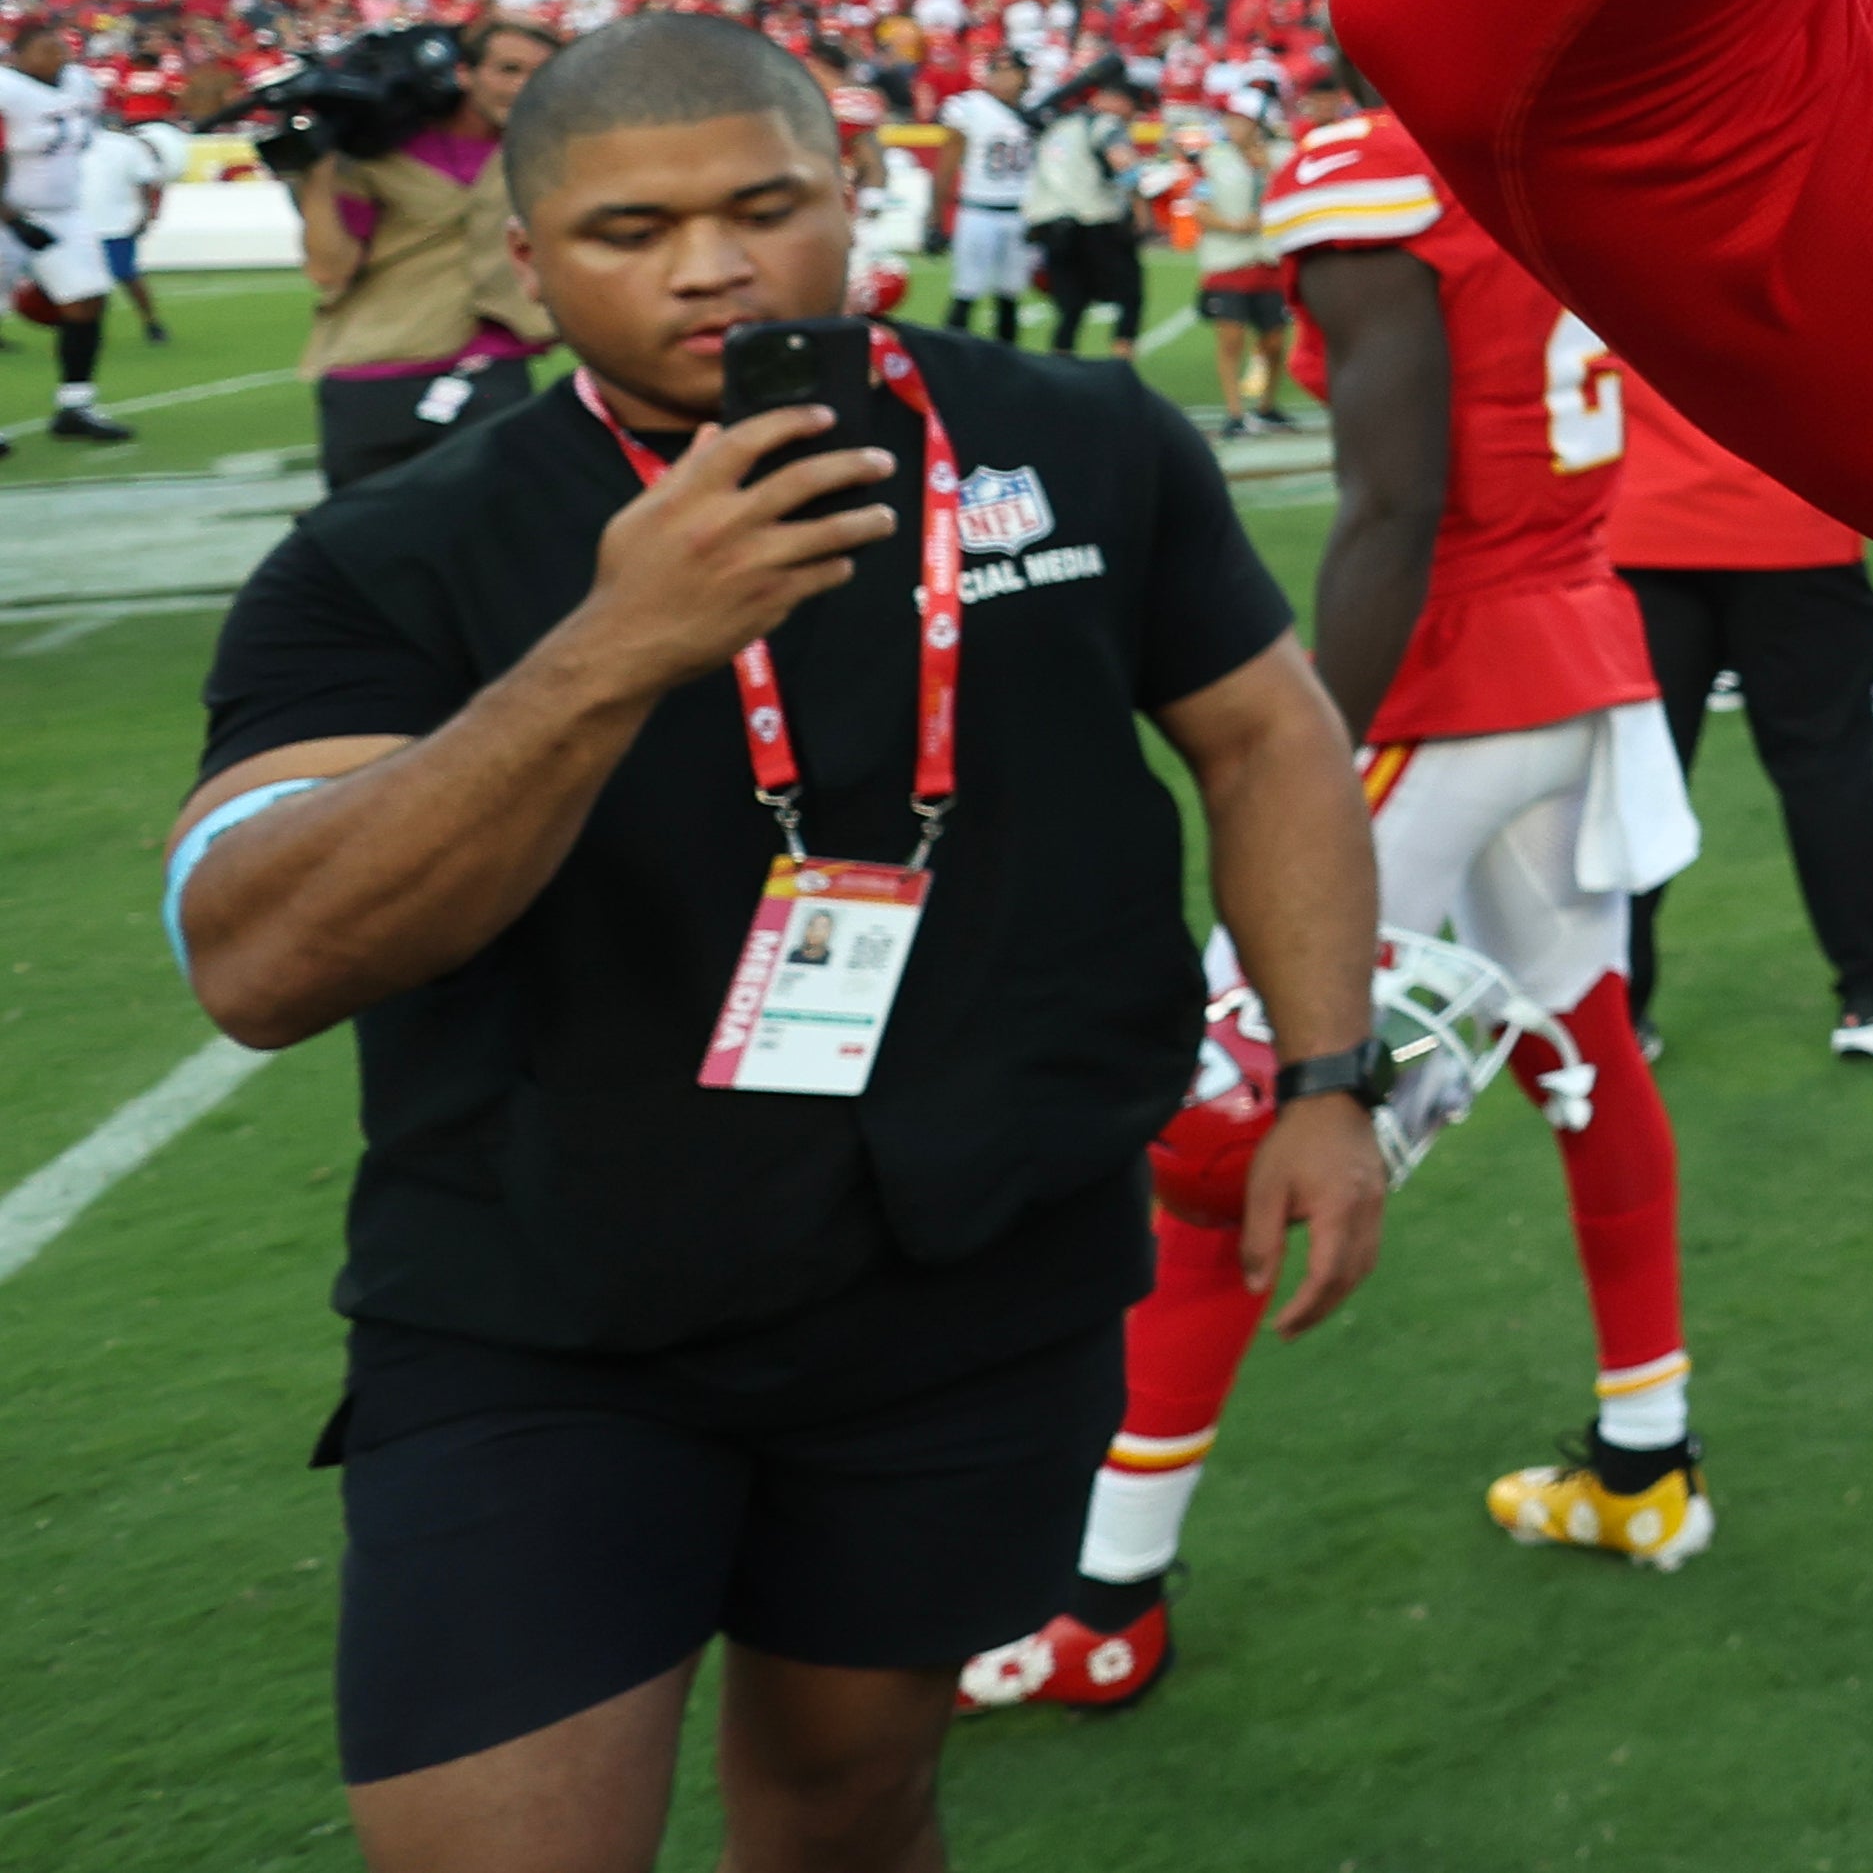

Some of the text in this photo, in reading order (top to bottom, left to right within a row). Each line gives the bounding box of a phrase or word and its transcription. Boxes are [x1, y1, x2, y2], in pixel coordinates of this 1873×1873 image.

[961, 498, 1040, 542] NFL
[912, 543, 1106, 615] SCIAL MEDIA
